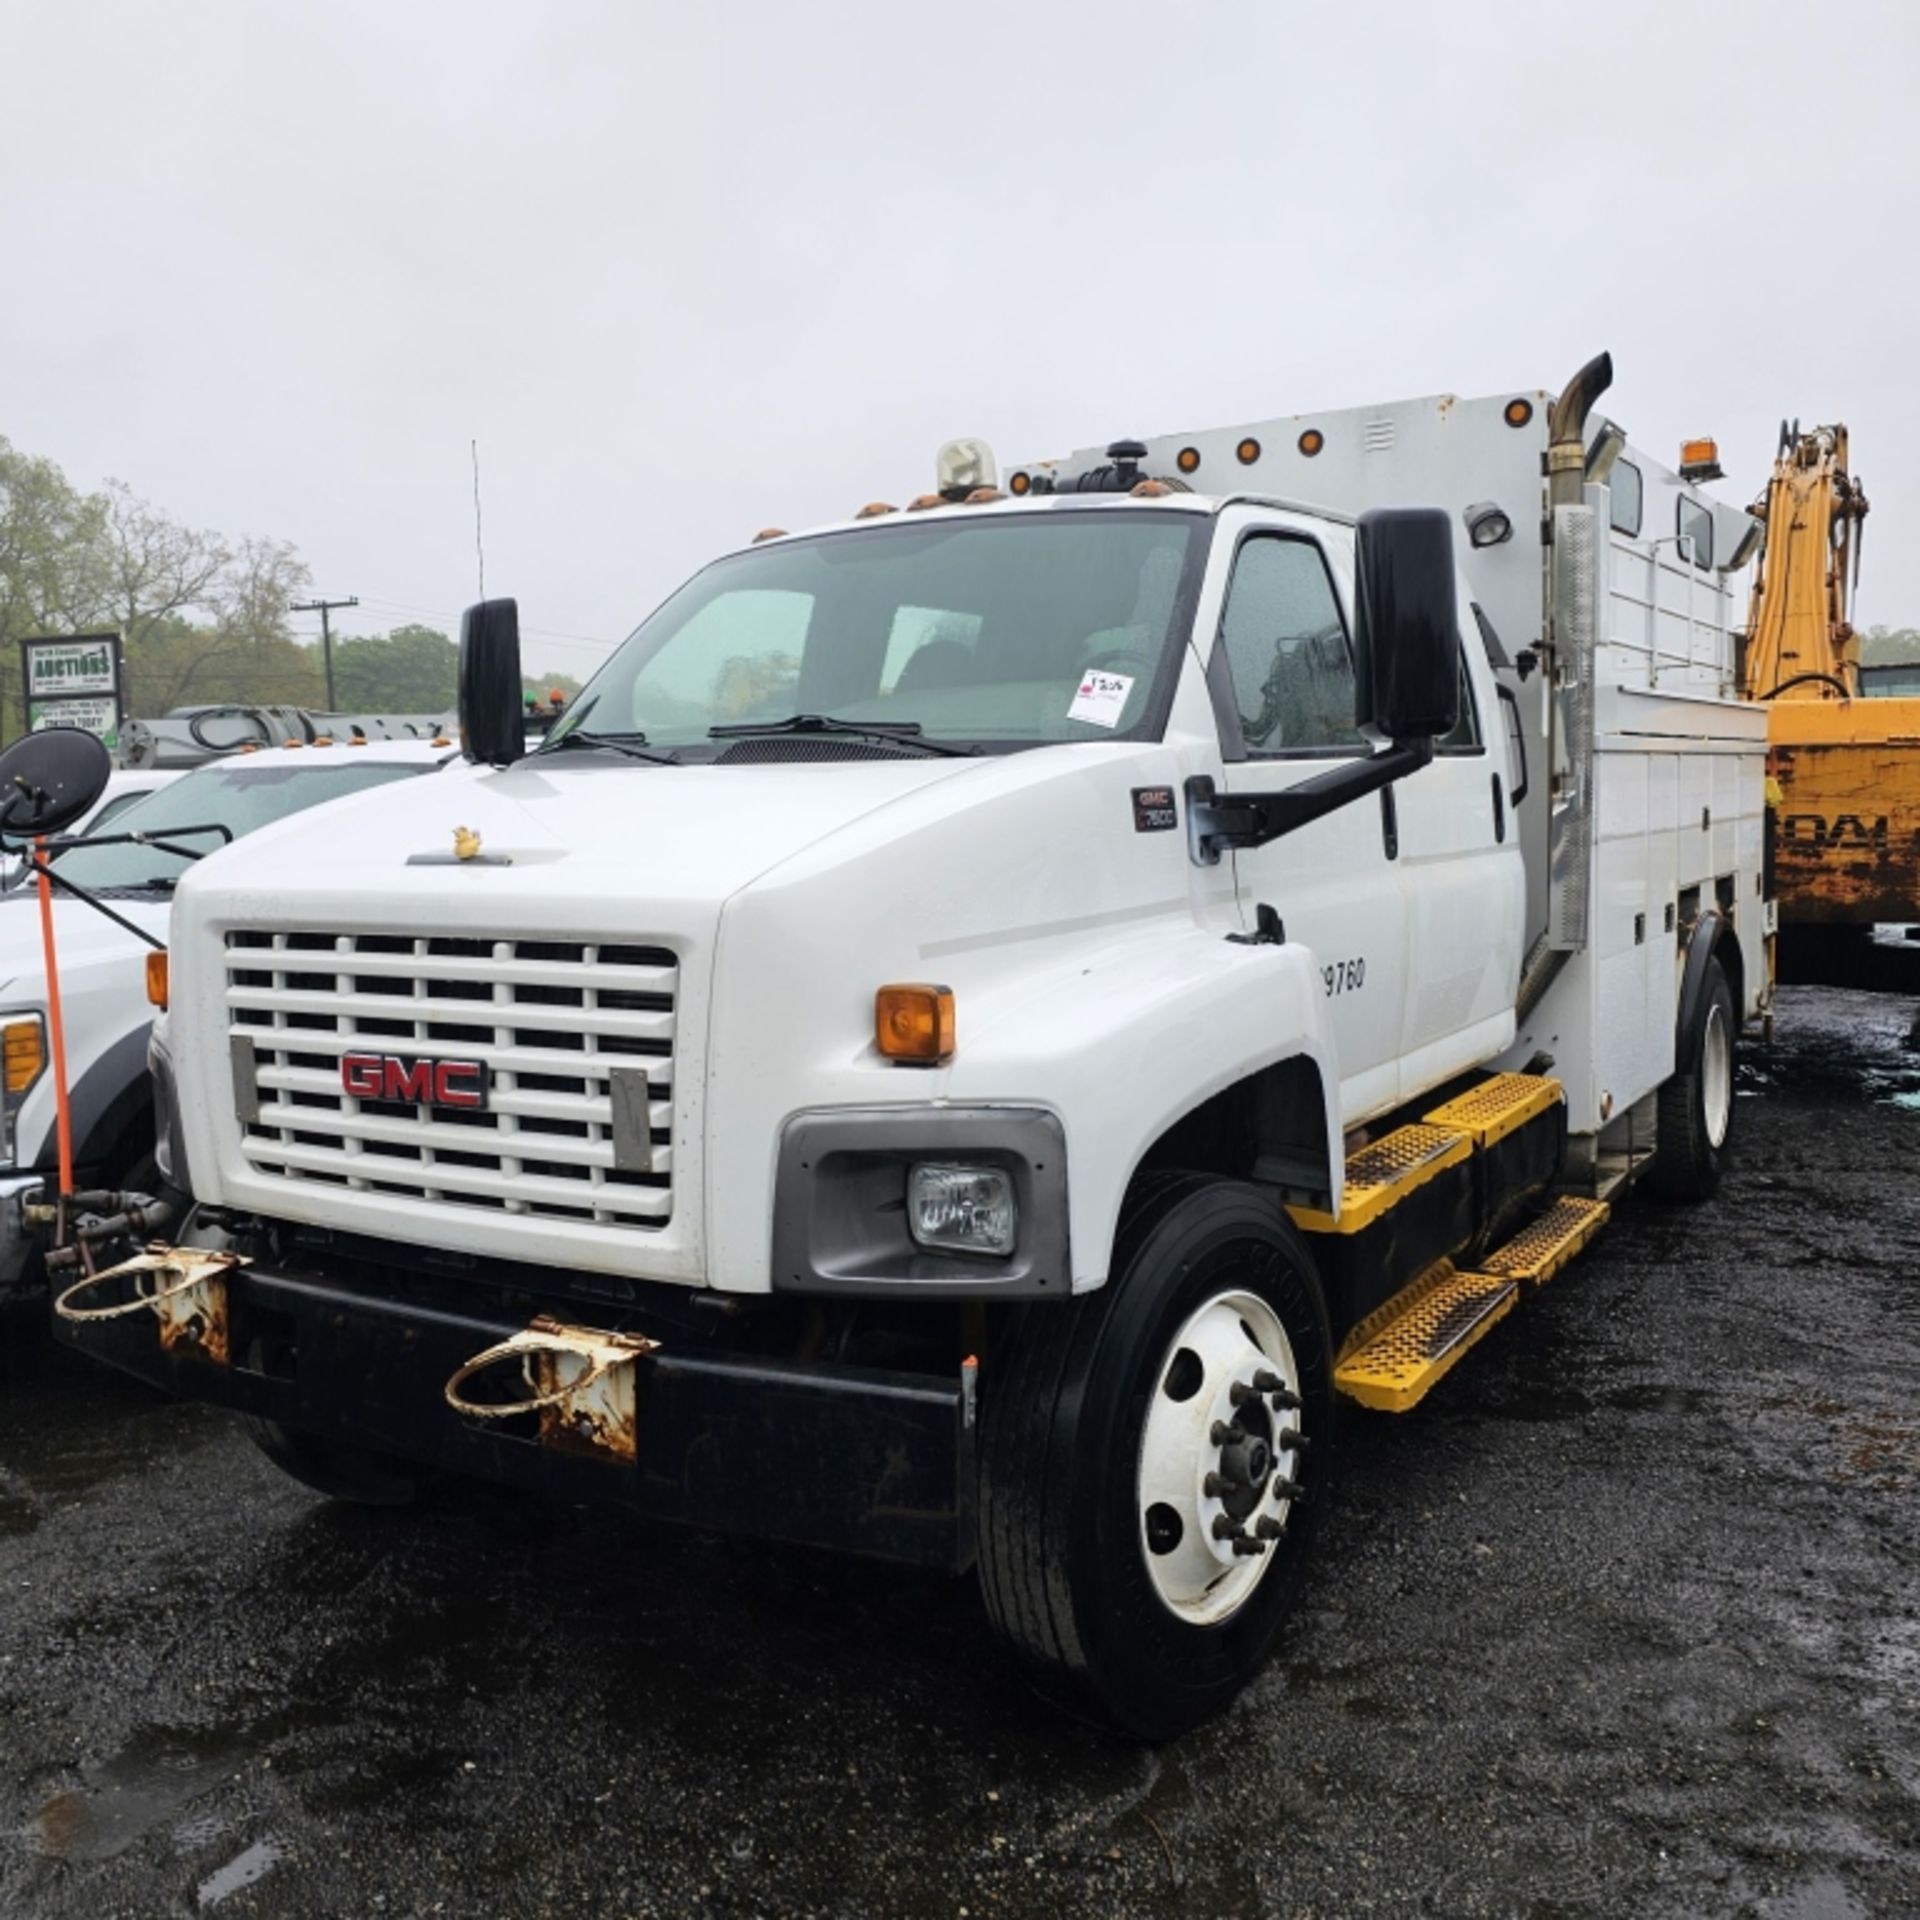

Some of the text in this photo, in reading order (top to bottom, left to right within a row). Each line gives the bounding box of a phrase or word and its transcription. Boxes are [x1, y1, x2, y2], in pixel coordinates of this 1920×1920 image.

[35, 655, 110, 679] AUCTIONS
[1139, 791, 1168, 806] GMC
[1319, 956, 1366, 998] 9760
[342, 1051, 481, 1107] GMC
